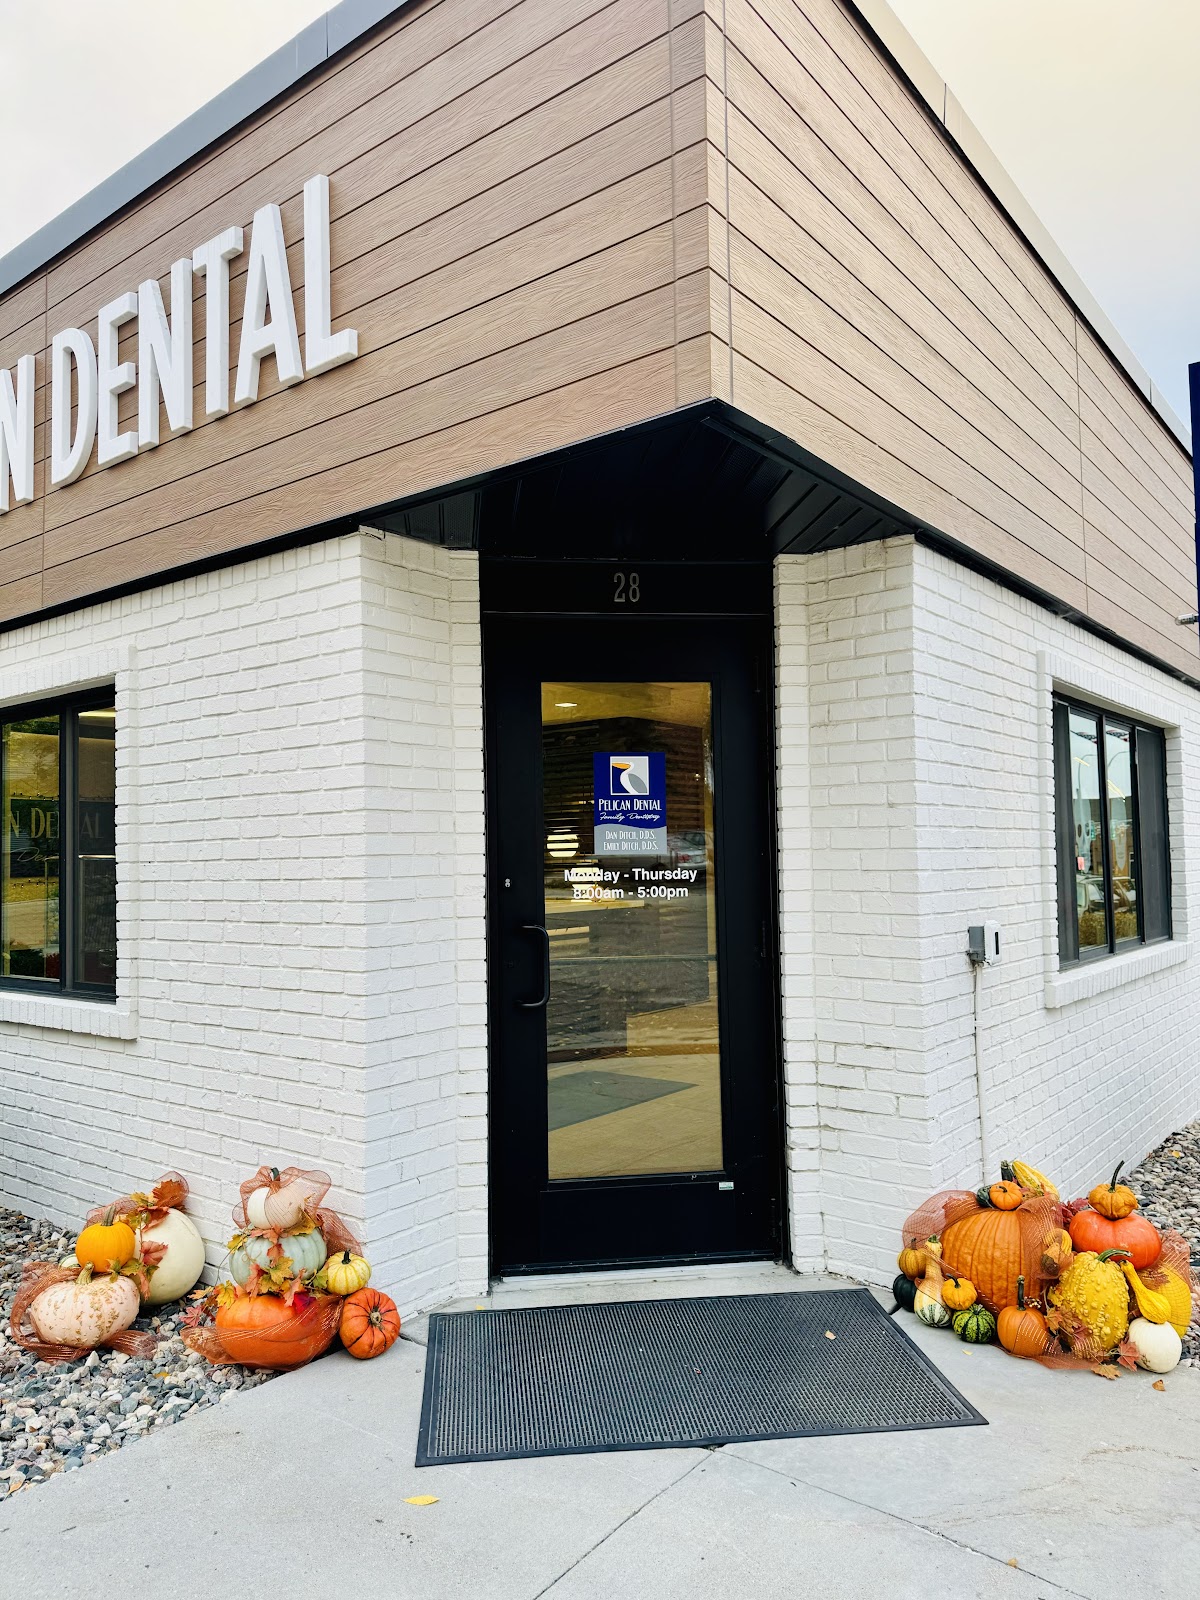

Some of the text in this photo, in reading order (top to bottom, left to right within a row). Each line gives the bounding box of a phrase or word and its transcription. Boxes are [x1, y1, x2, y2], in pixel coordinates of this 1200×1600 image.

[51, 173, 358, 487] DENTAL
[613, 572, 641, 602] 28
[598, 798, 662, 811] PELICAN DENTAL
[600, 812, 661, 822] Family Dentistry
[605, 830, 618, 840] DAN
[639, 830, 657, 840] D.D.S.
[603, 841, 620, 851] EMILY
[641, 840, 659, 851] D.D.S.
[564, 868, 620, 884] Monday
[631, 867, 698, 882] Thursday
[573, 886, 624, 900] 8:00am
[637, 885, 689, 900] 5:00pm
